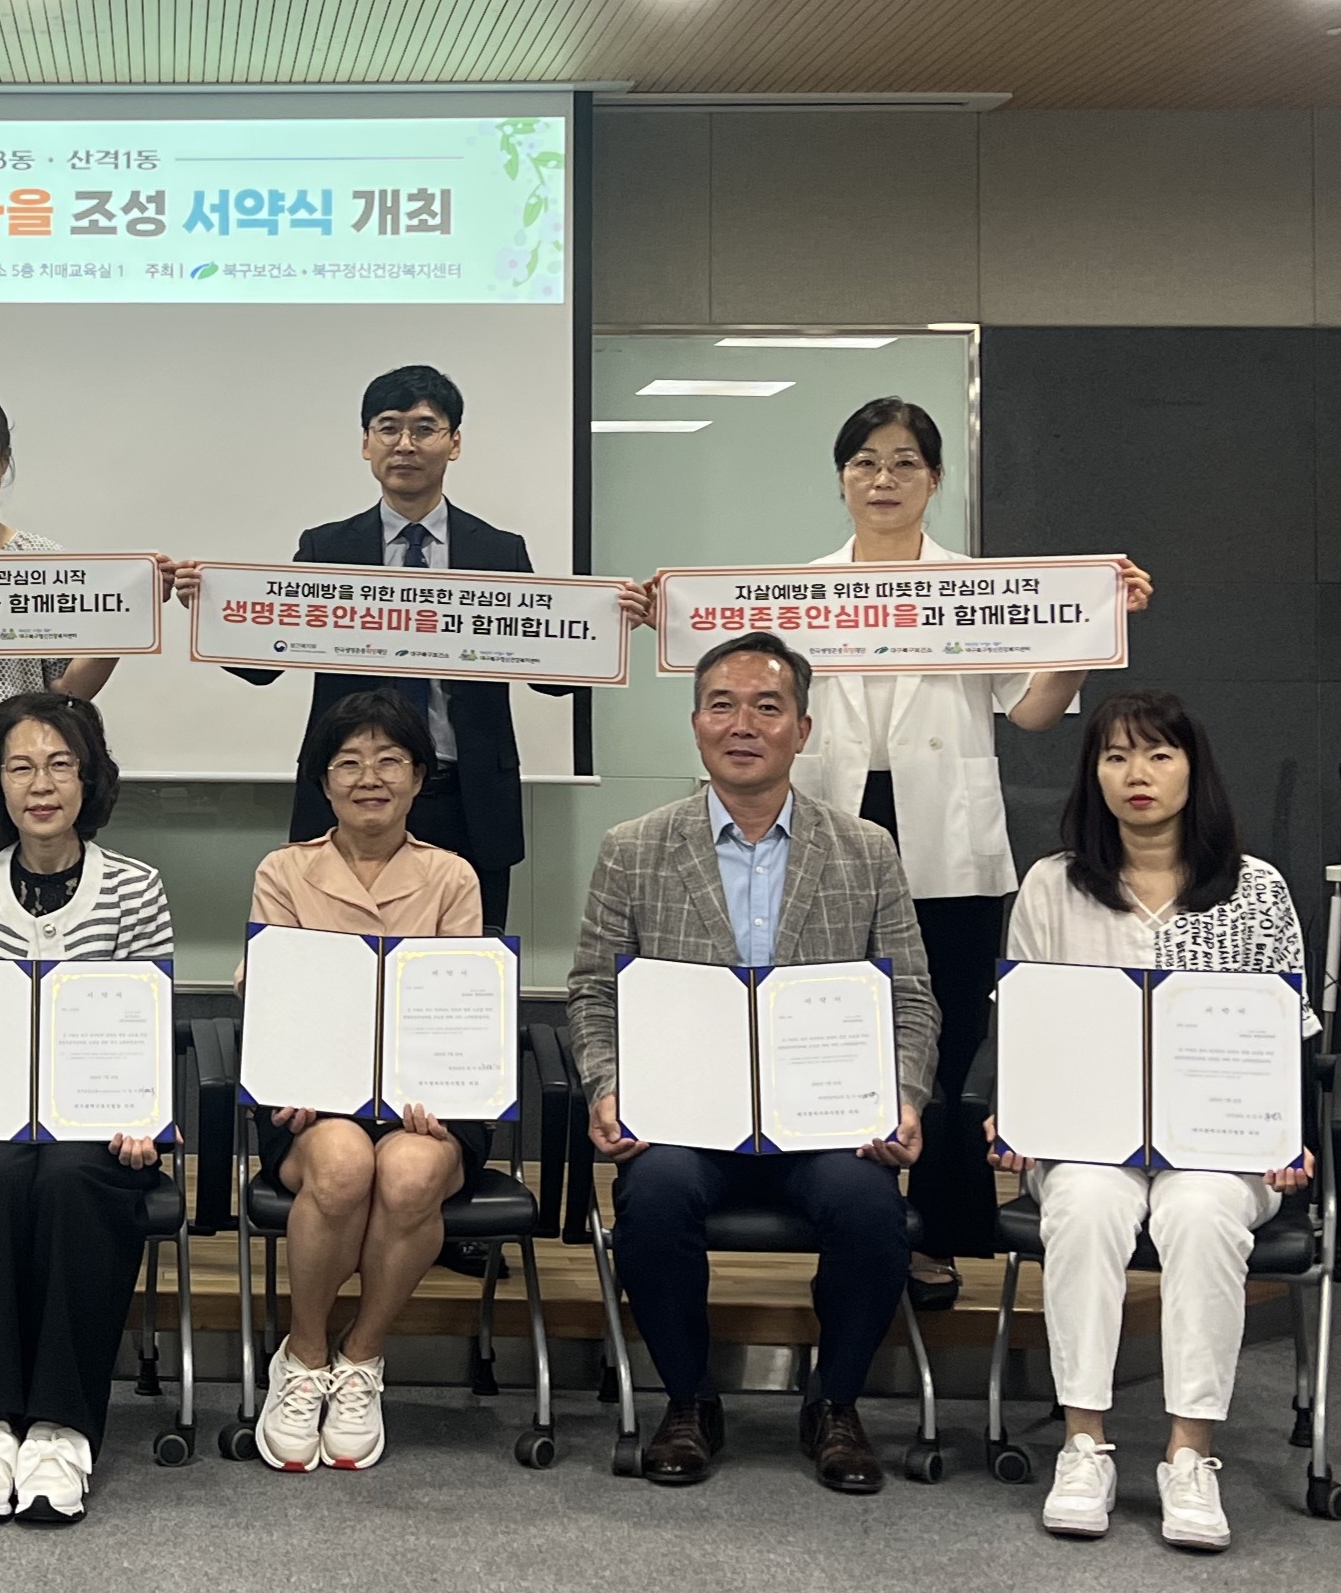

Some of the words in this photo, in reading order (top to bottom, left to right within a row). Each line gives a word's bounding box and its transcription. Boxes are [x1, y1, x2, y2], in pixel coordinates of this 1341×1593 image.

[67, 150, 161, 170] 산격1동
[69, 189, 167, 237] 조성
[182, 188, 332, 236] 서약식
[351, 188, 451, 236] 개최
[12, 263, 34, 278] 5층
[39, 262, 112, 278] 치매교육실
[117, 264, 125, 277] 1
[145, 263, 174, 278] 주최
[222, 263, 297, 279] 북구보건소
[312, 263, 462, 279] 북구정신건강복지센터
[53, 569, 86, 586] 시작
[734, 582, 827, 601] 자살예방을
[833, 581, 870, 599] 위한
[876, 580, 932, 598] 따뜻한
[938, 579, 994, 597] 관심의
[1002, 578, 1040, 596] 시작
[9, 593, 130, 615] 함께합니다.
[265, 581, 354, 600] 자살예방을
[360, 585, 395, 602] 위한
[400, 586, 453, 605] 따뜻한
[459, 589, 512, 608] 관심의
[519, 591, 553, 610] 시작
[222, 600, 463, 635] 생명존중안심마을과
[471, 613, 596, 641] 함께합니다.
[689, 604, 945, 631] 생명존중안심마을과
[954, 603, 1090, 627] 함께합니다.
[1242, 872, 1253, 899] DISS
[1254, 869, 1267, 904] FLOW
[1189, 914, 1202, 947] MUSI
[1203, 912, 1215, 950] TRAP
[1253, 943, 1267, 972] BEAT
